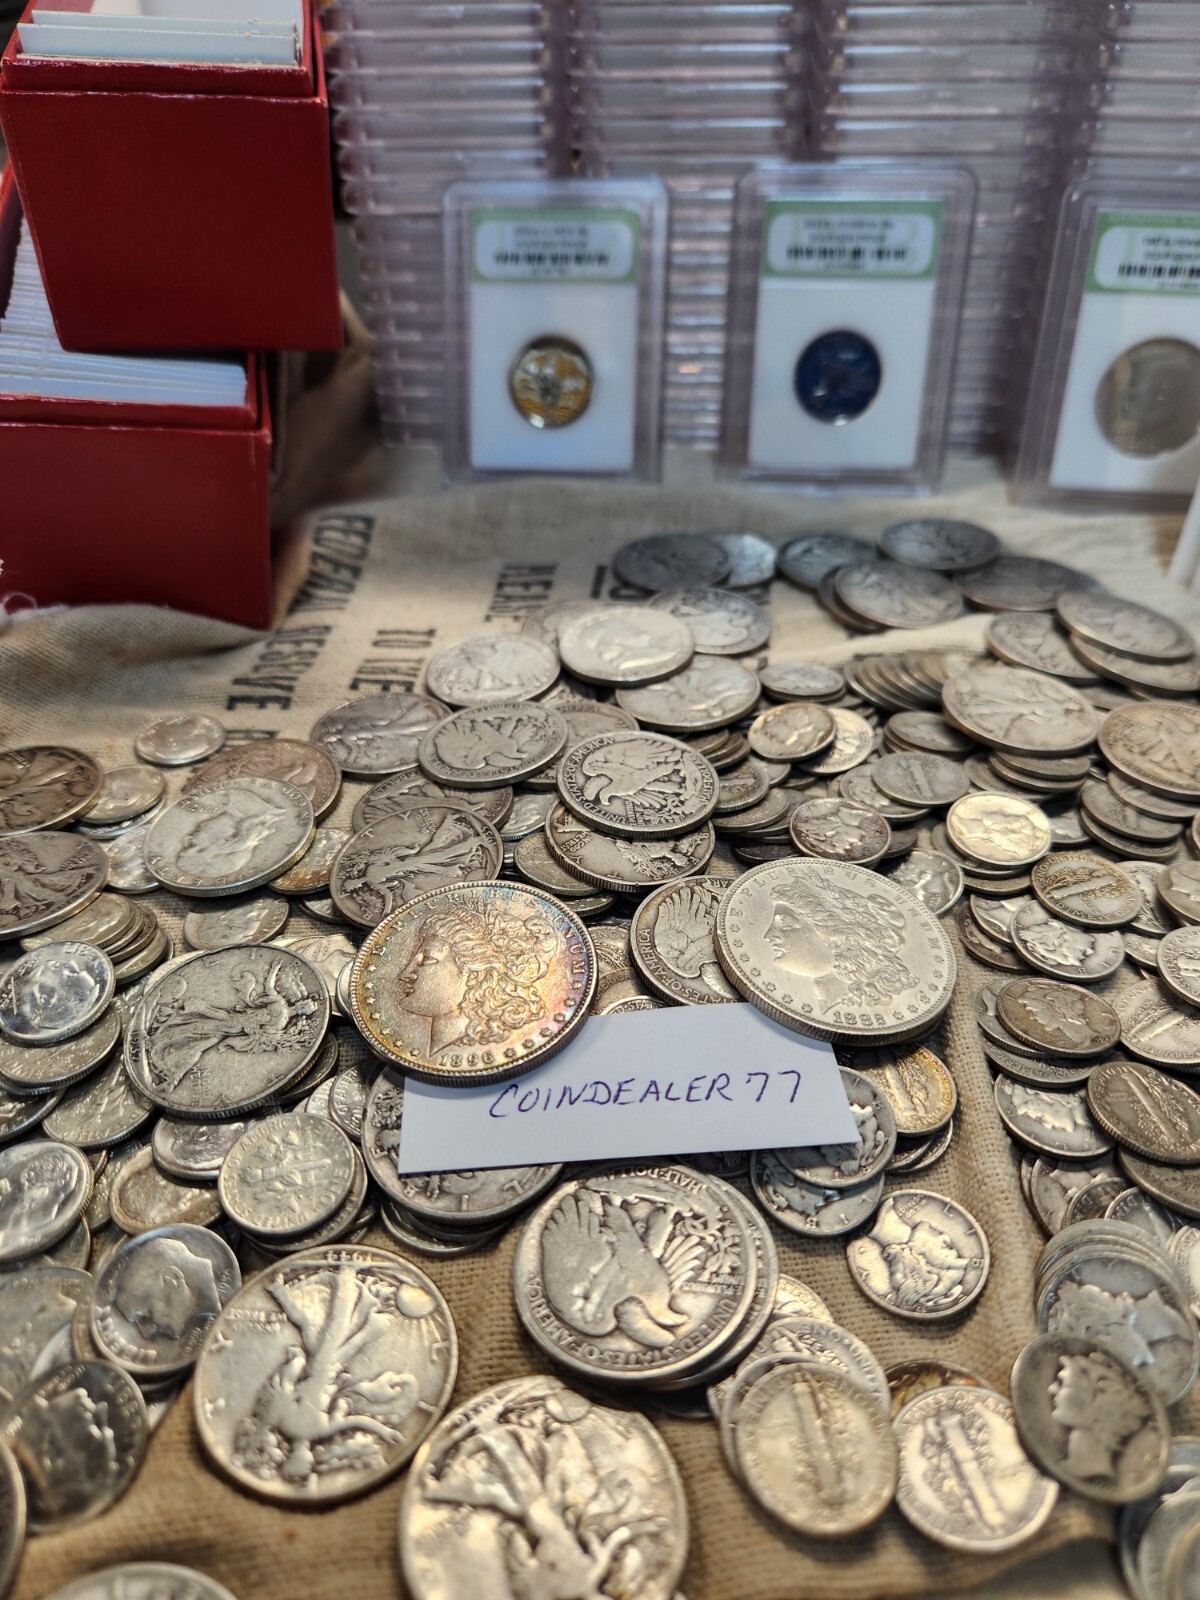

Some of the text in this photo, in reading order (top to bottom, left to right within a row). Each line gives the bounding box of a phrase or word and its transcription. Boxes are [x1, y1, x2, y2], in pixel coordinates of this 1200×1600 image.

[287, 514, 375, 617] FEDERAL
[372, 628, 437, 648] TO
[639, 928, 667, 976] AMERICA
[438, 1051, 495, 1067] 1896
